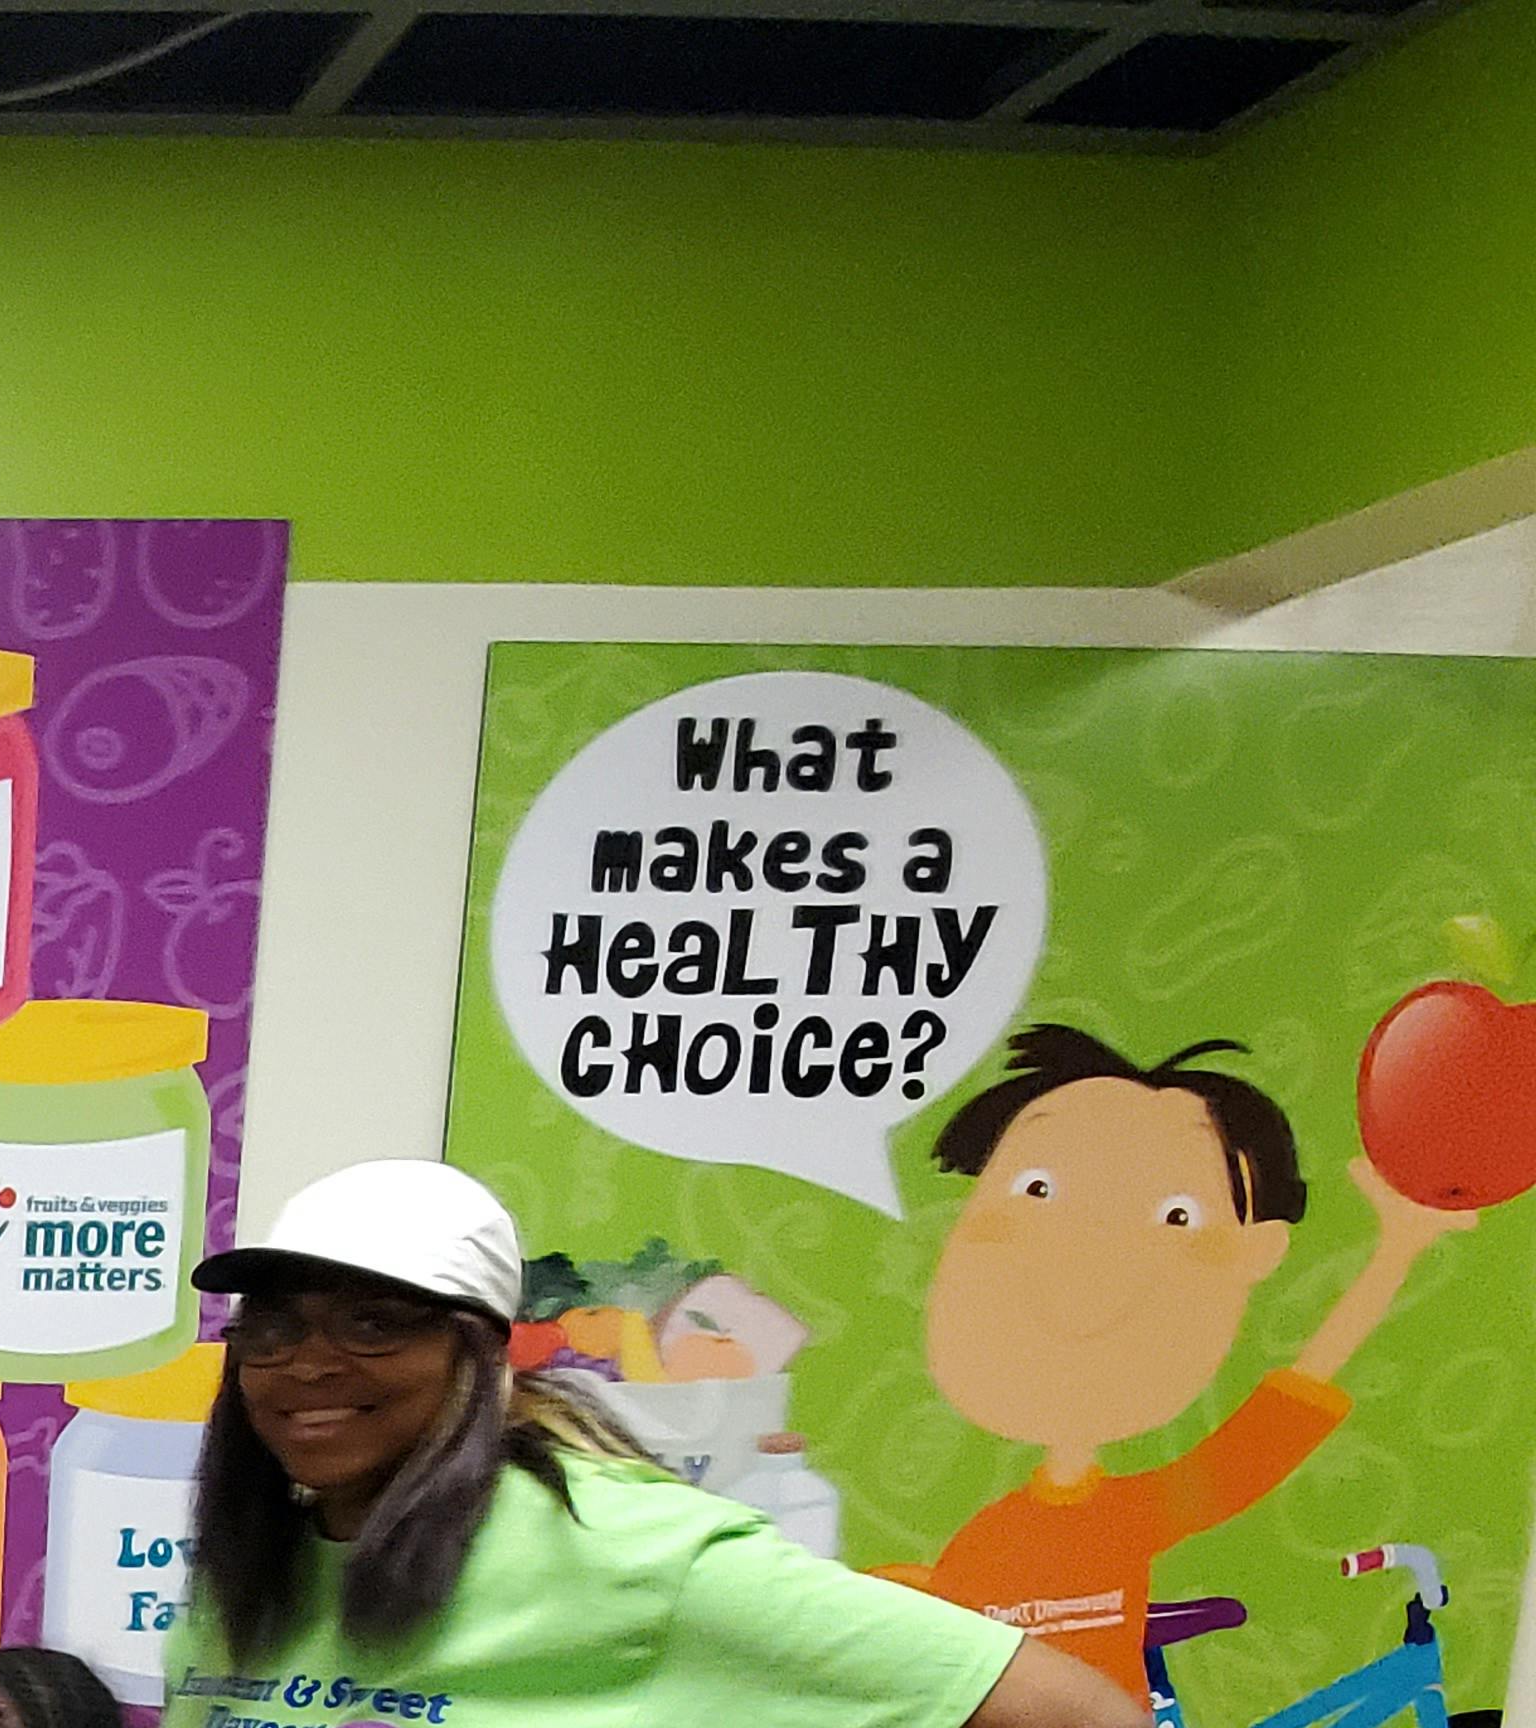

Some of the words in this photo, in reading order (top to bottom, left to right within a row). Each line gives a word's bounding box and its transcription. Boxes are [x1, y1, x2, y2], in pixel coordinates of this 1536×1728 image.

[675, 717, 897, 793] What
[591, 819, 869, 894] makes
[902, 827, 953, 893] a
[25, 1220, 166, 1259] more
[283, 1674, 322, 1708] &
